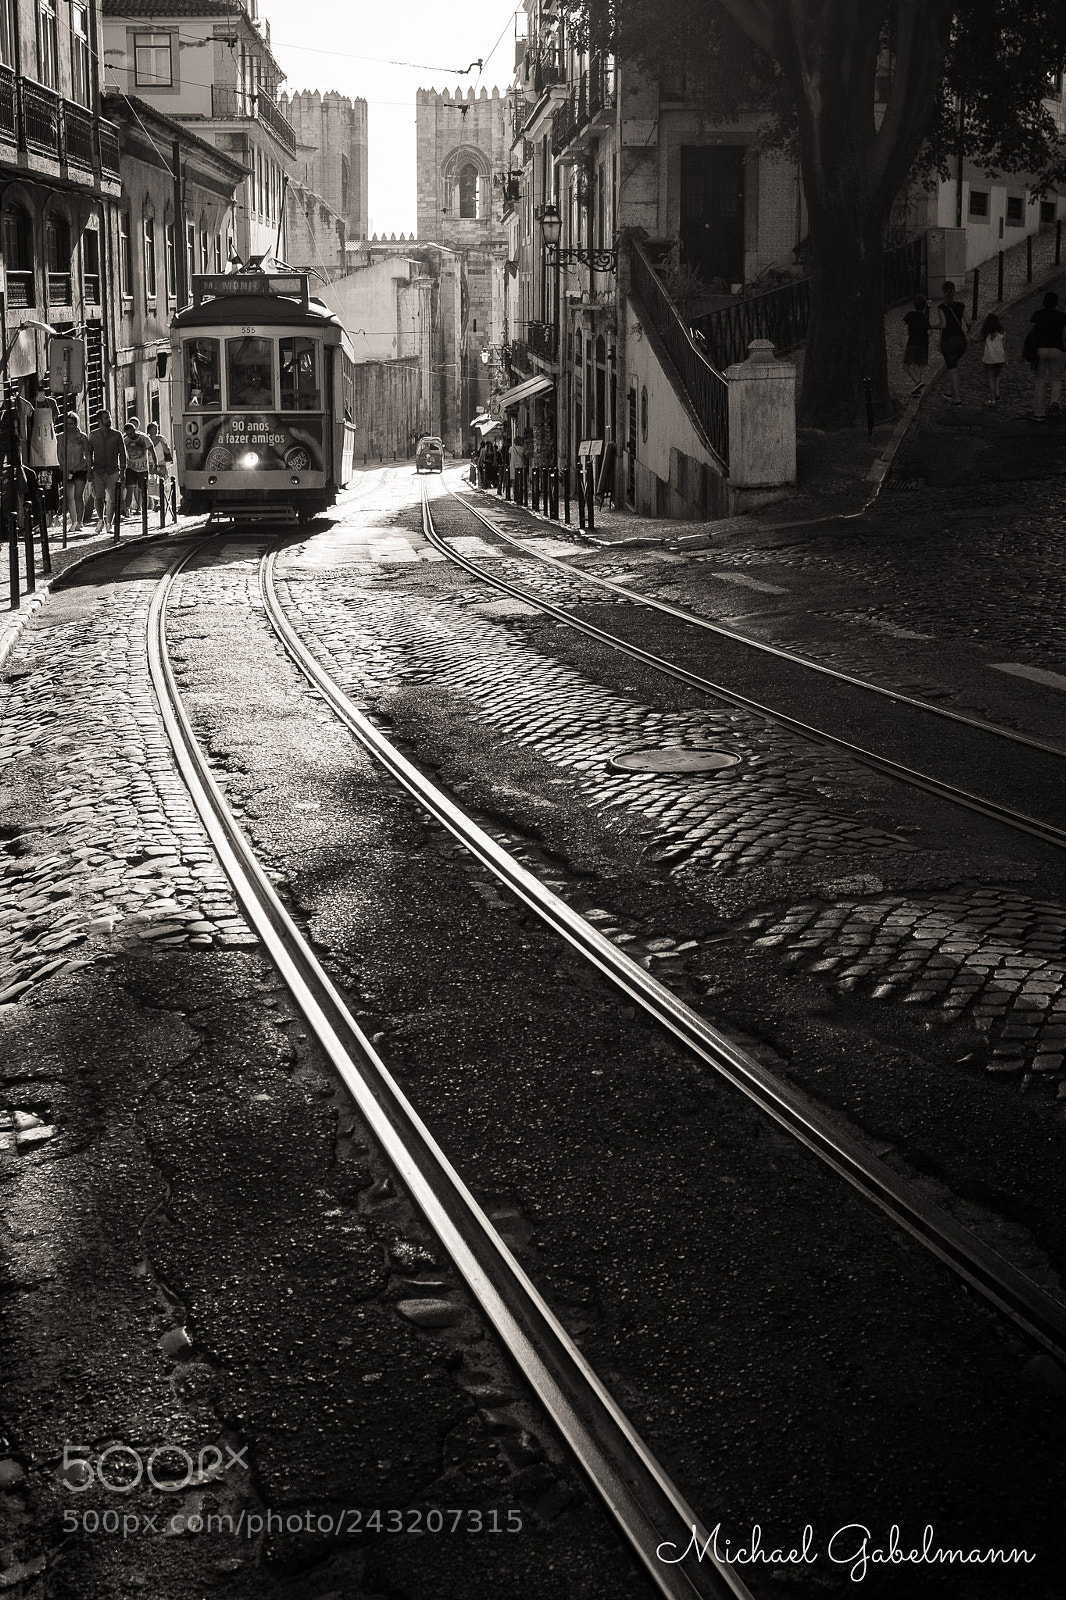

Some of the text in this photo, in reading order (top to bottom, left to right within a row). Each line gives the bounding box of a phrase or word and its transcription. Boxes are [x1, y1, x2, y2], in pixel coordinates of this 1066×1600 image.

[232, 421, 270, 432] 90 anos
[218, 432, 285, 446] a fazer amigos
